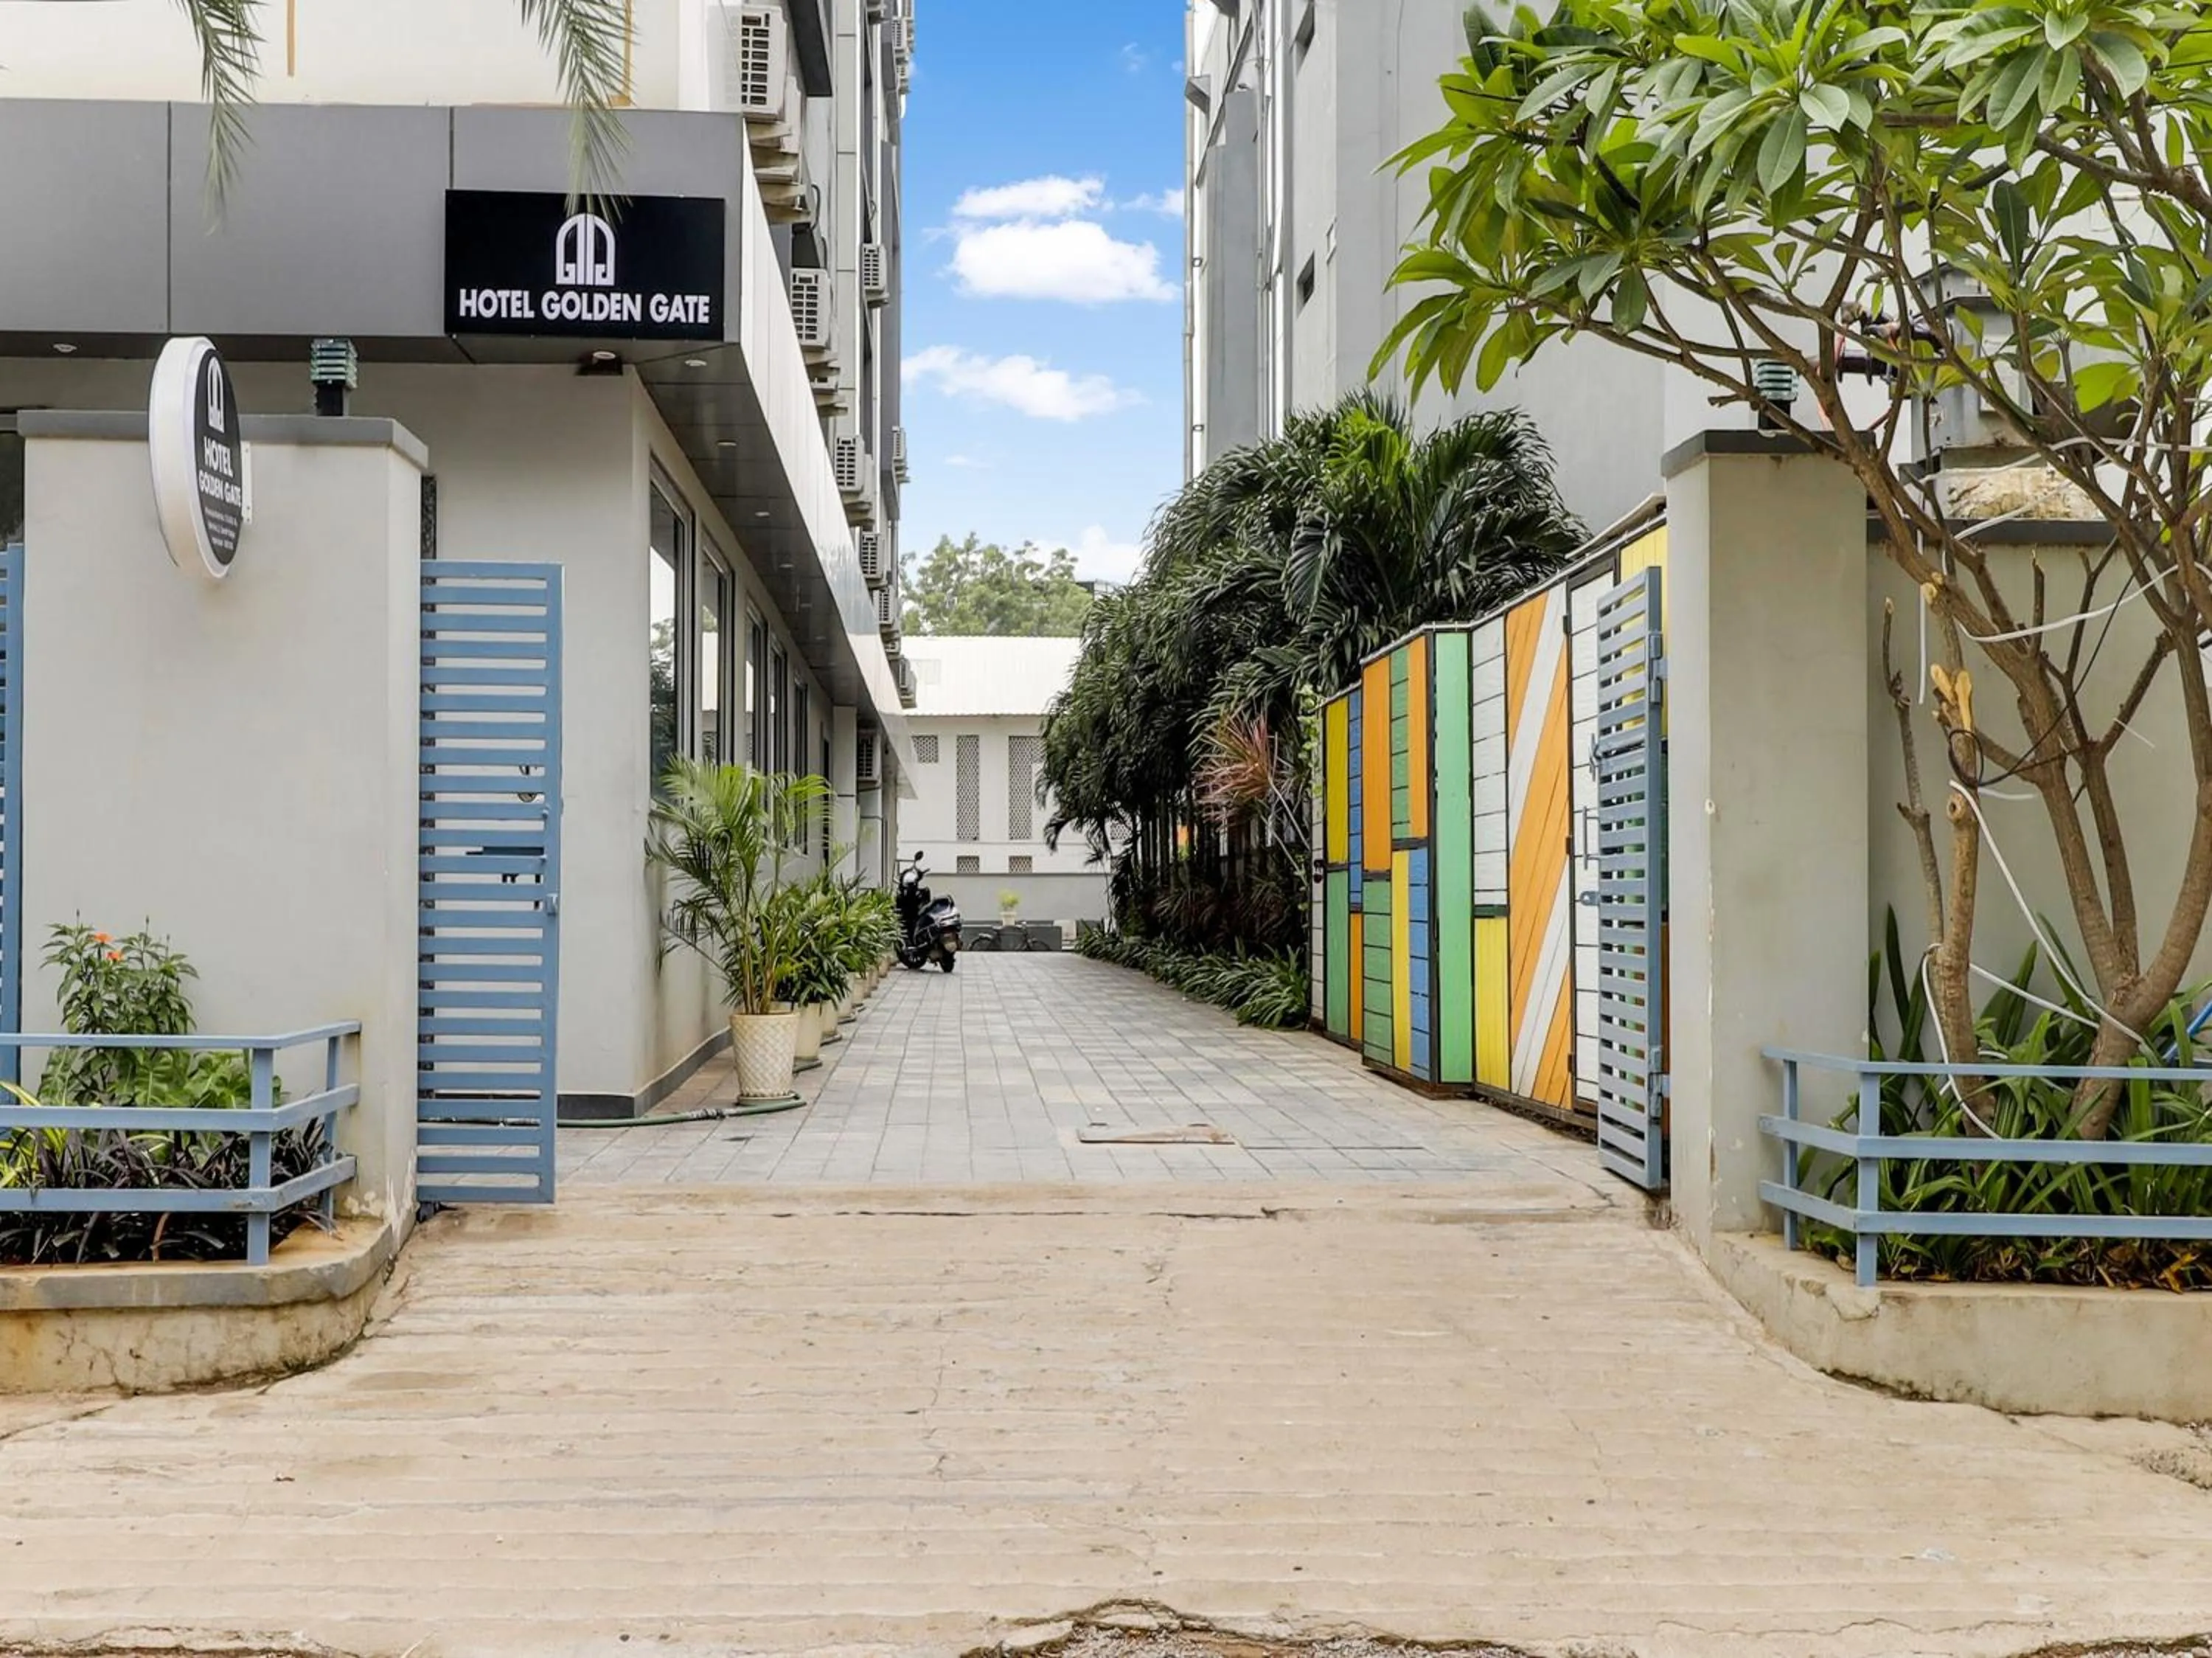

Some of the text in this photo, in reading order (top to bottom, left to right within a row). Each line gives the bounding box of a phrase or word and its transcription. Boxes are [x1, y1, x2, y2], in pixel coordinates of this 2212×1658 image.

[459, 289, 710, 324] HOTEL GOLDEN GATE
[204, 436, 234, 477] HOTEL
[199, 470, 241, 507] GOLDEN GATE
